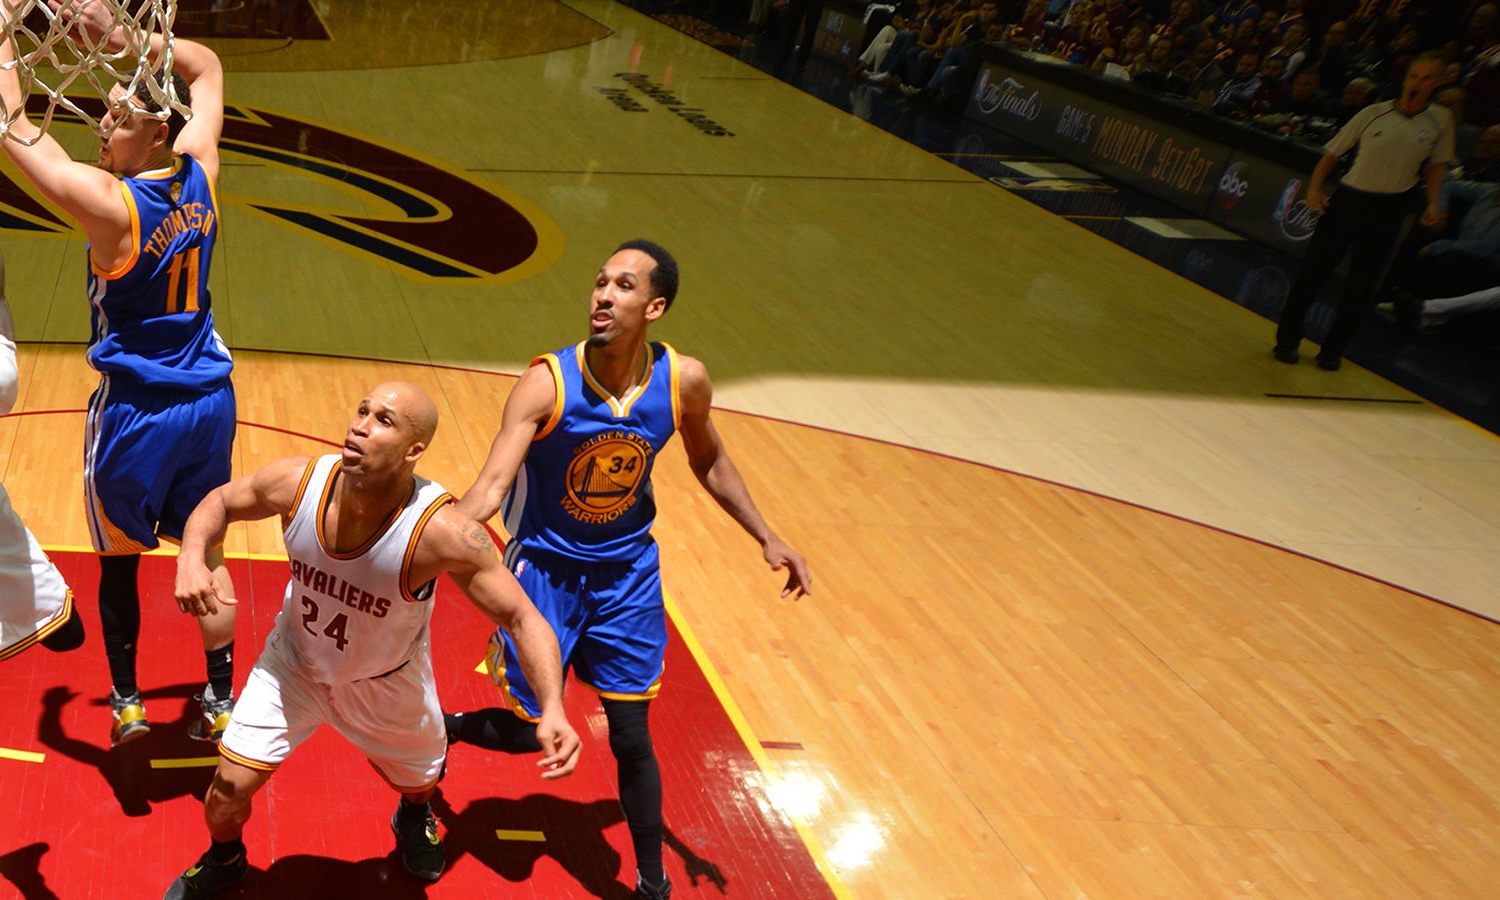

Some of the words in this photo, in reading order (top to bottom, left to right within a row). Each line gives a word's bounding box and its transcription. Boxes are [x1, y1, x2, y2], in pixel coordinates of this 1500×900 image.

[1092, 116, 1158, 171] MONDAY
[1220, 167, 1249, 190] abc
[144, 202, 216, 260] THOMPSN
[165, 247, 201, 314] 11
[572, 430, 627, 455] GOLDEN
[607, 454, 637, 475] 34
[558, 494, 637, 525] WARRIORS
[290, 559, 392, 619] AVALIERS
[301, 595, 349, 653] 24
